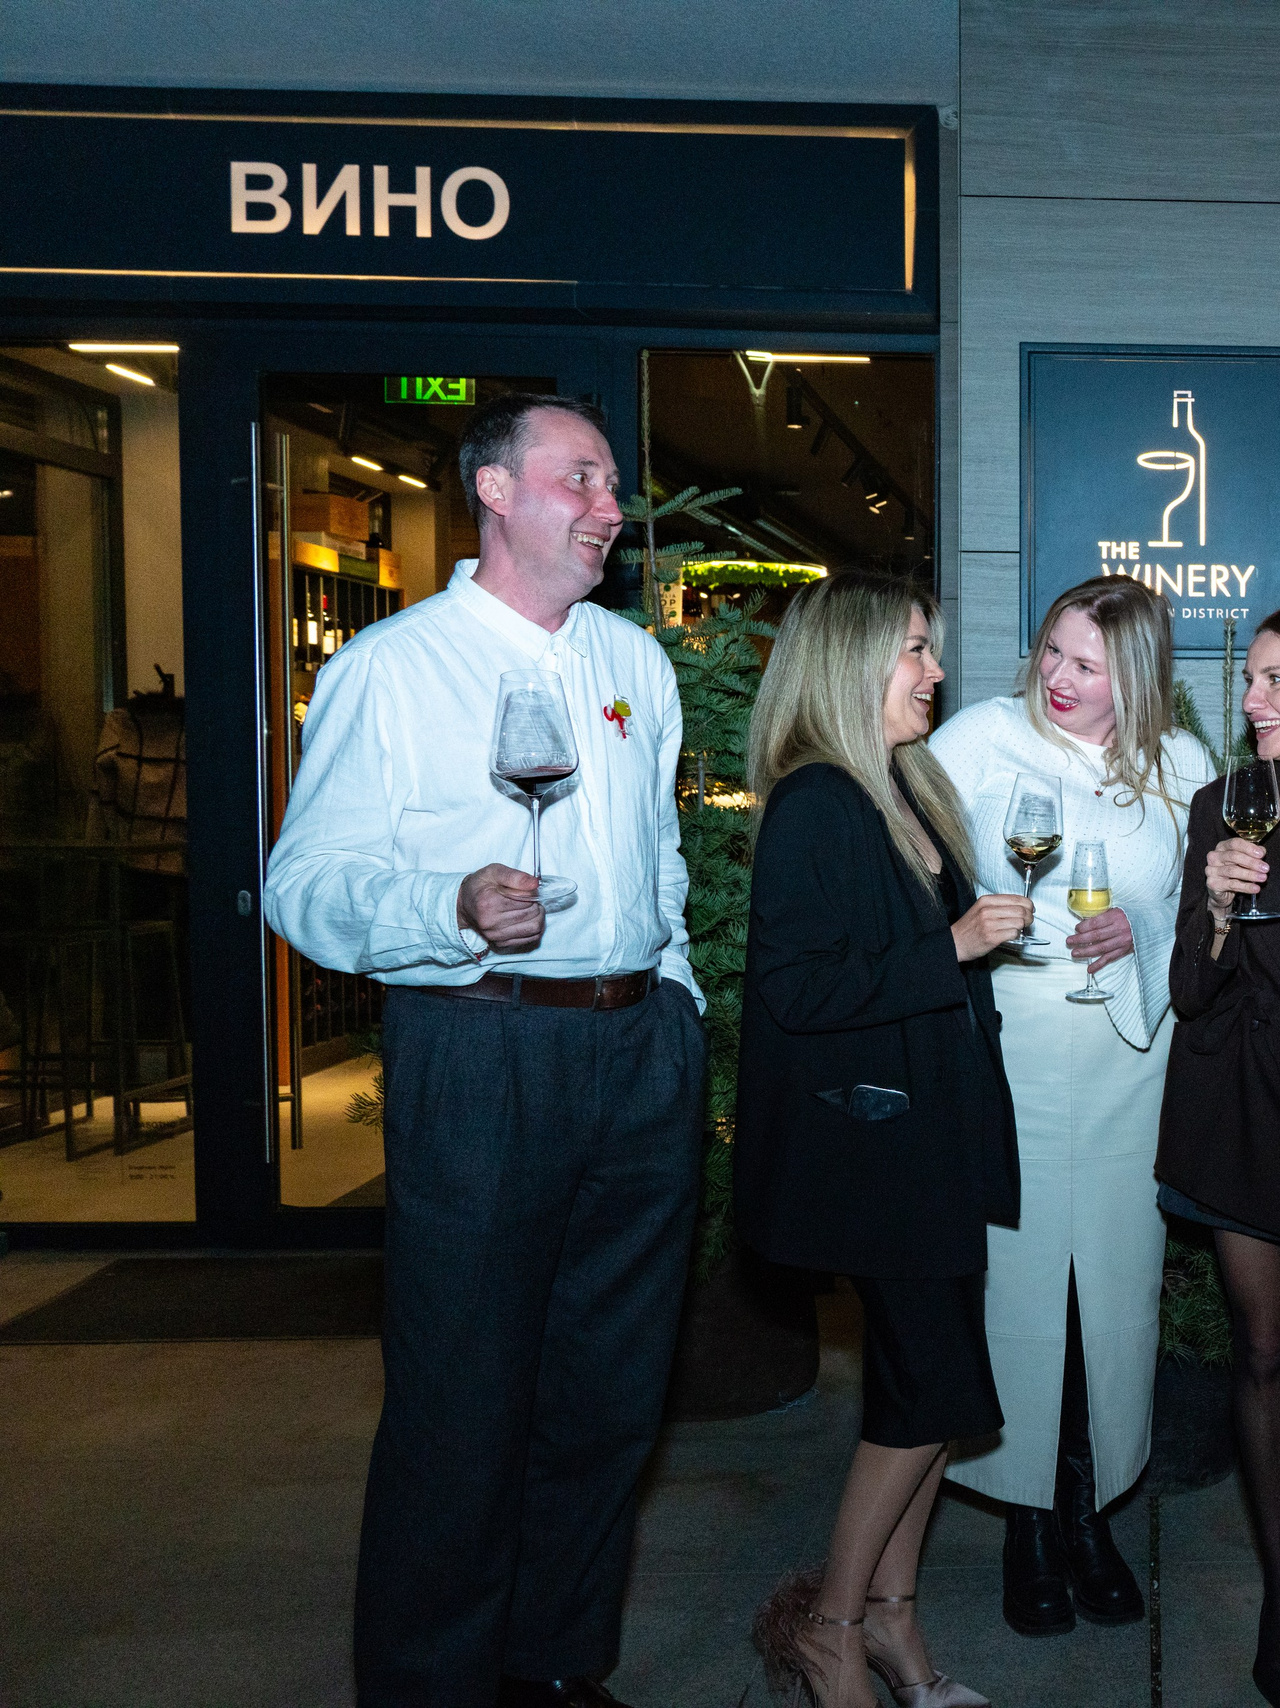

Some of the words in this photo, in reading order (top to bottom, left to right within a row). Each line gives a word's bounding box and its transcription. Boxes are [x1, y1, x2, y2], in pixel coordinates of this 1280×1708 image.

[229, 162, 511, 240] ВИНО
[1098, 541, 1140, 560] THE
[1182, 607, 1250, 619] DISTRICT
